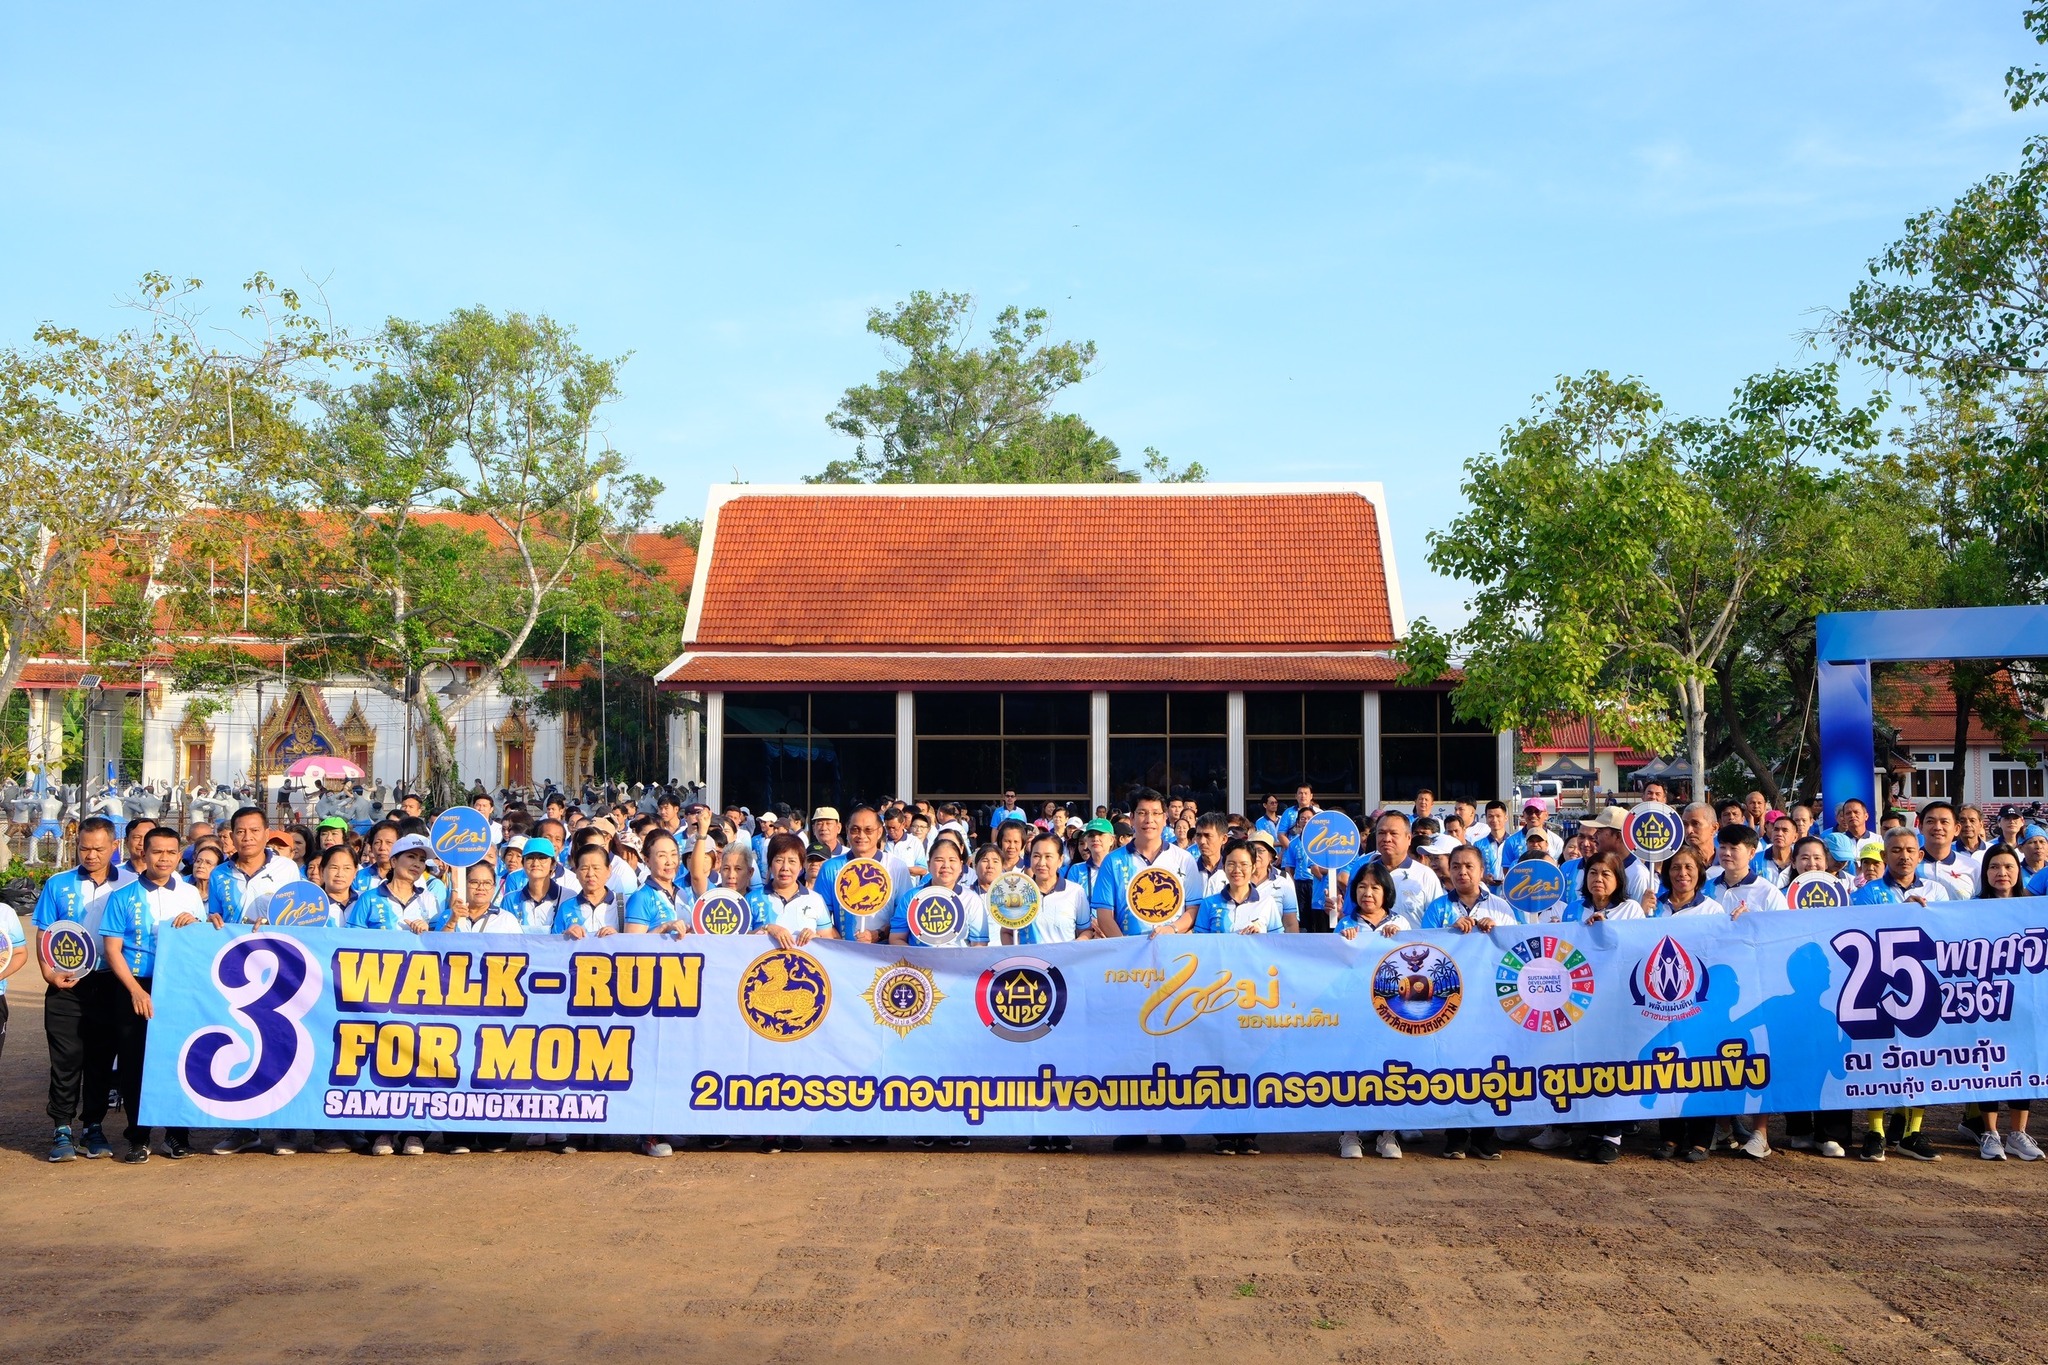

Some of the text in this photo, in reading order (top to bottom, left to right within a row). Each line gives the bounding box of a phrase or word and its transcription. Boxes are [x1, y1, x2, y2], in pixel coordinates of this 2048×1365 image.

[67, 892, 76, 917] WALK
[1104, 967, 1165, 988] กองทุน
[1528, 985, 1562, 993] GOALS
[1832, 928, 2048, 1022] 25 พฤศจิ
[1939, 979, 2009, 1018] 2567
[183, 936, 310, 1105] 3
[1236, 1002, 1339, 1029] ของแผ่นดิน
[335, 1024, 634, 1081] FOR MOM
[1844, 1039, 2006, 1072] ณ วัดบางกุ้ง
[694, 1042, 1767, 1122] 2 ทศวรรษ กองทุนแม่ของแผ่นดิน ครอบครัวอบอุ่น ชุมชนเข้มแข็ง
[1846, 1077, 1925, 1099] ต.บางกุ้ง
[1931, 1070, 2022, 1091] อ.บางคนที
[324, 1090, 606, 1119] SAMUTSONGKHRAM
